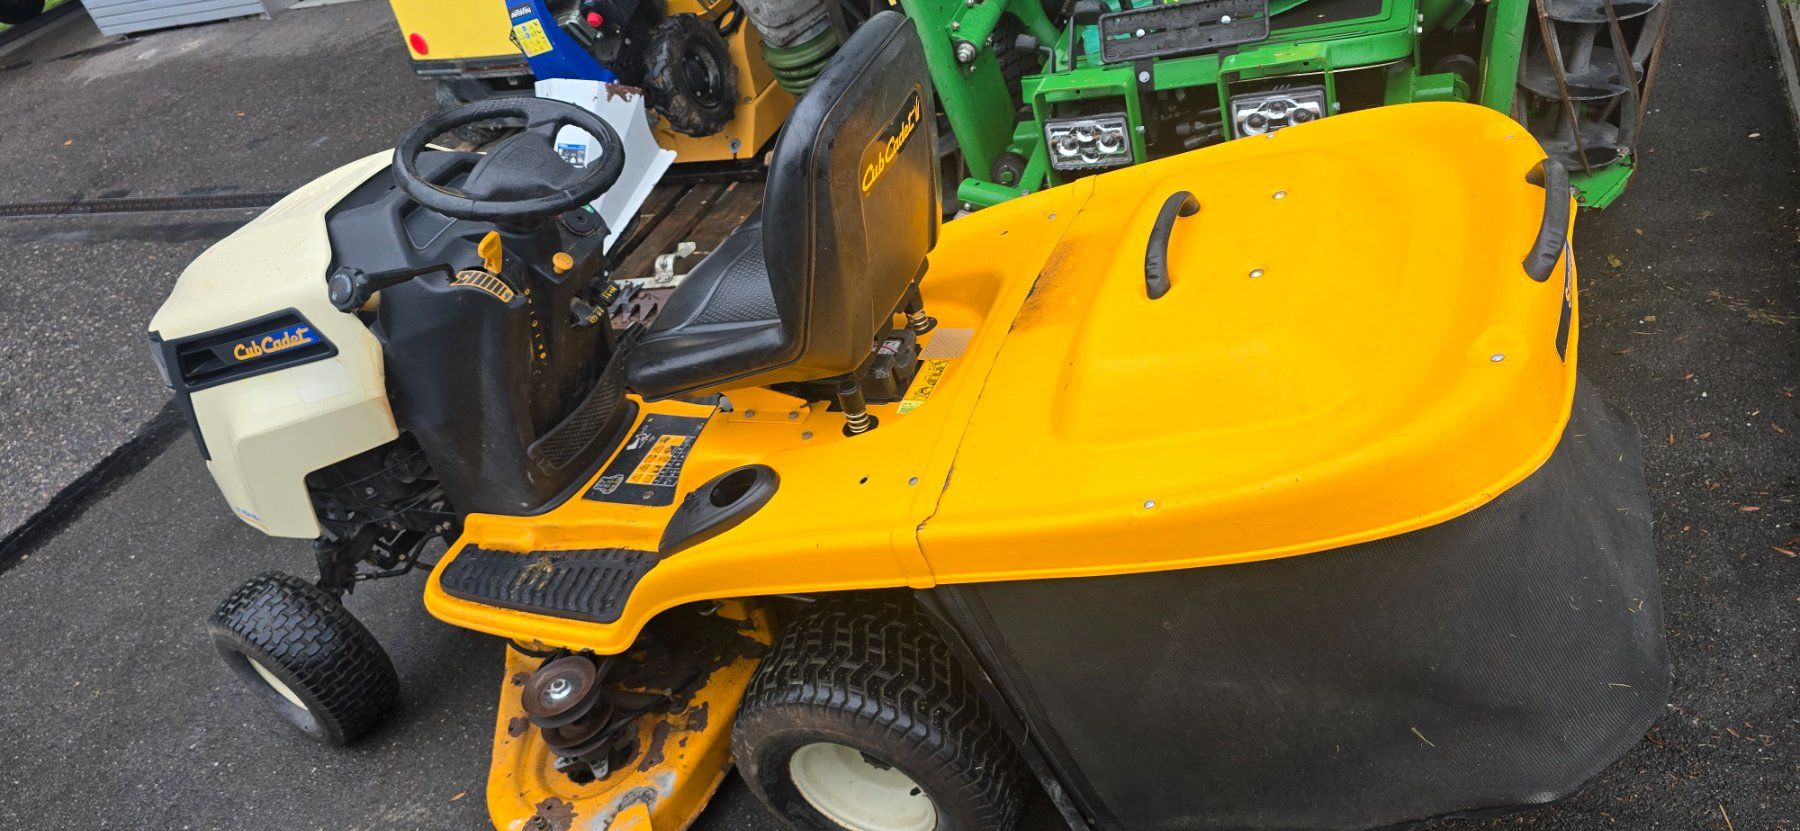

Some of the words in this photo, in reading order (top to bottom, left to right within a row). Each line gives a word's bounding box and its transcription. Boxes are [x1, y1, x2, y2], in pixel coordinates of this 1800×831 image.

[862, 151, 885, 192] Cub
[885, 106, 916, 163] Cadet
[234, 340, 263, 361] Cub
[260, 327, 312, 354] Cadet
